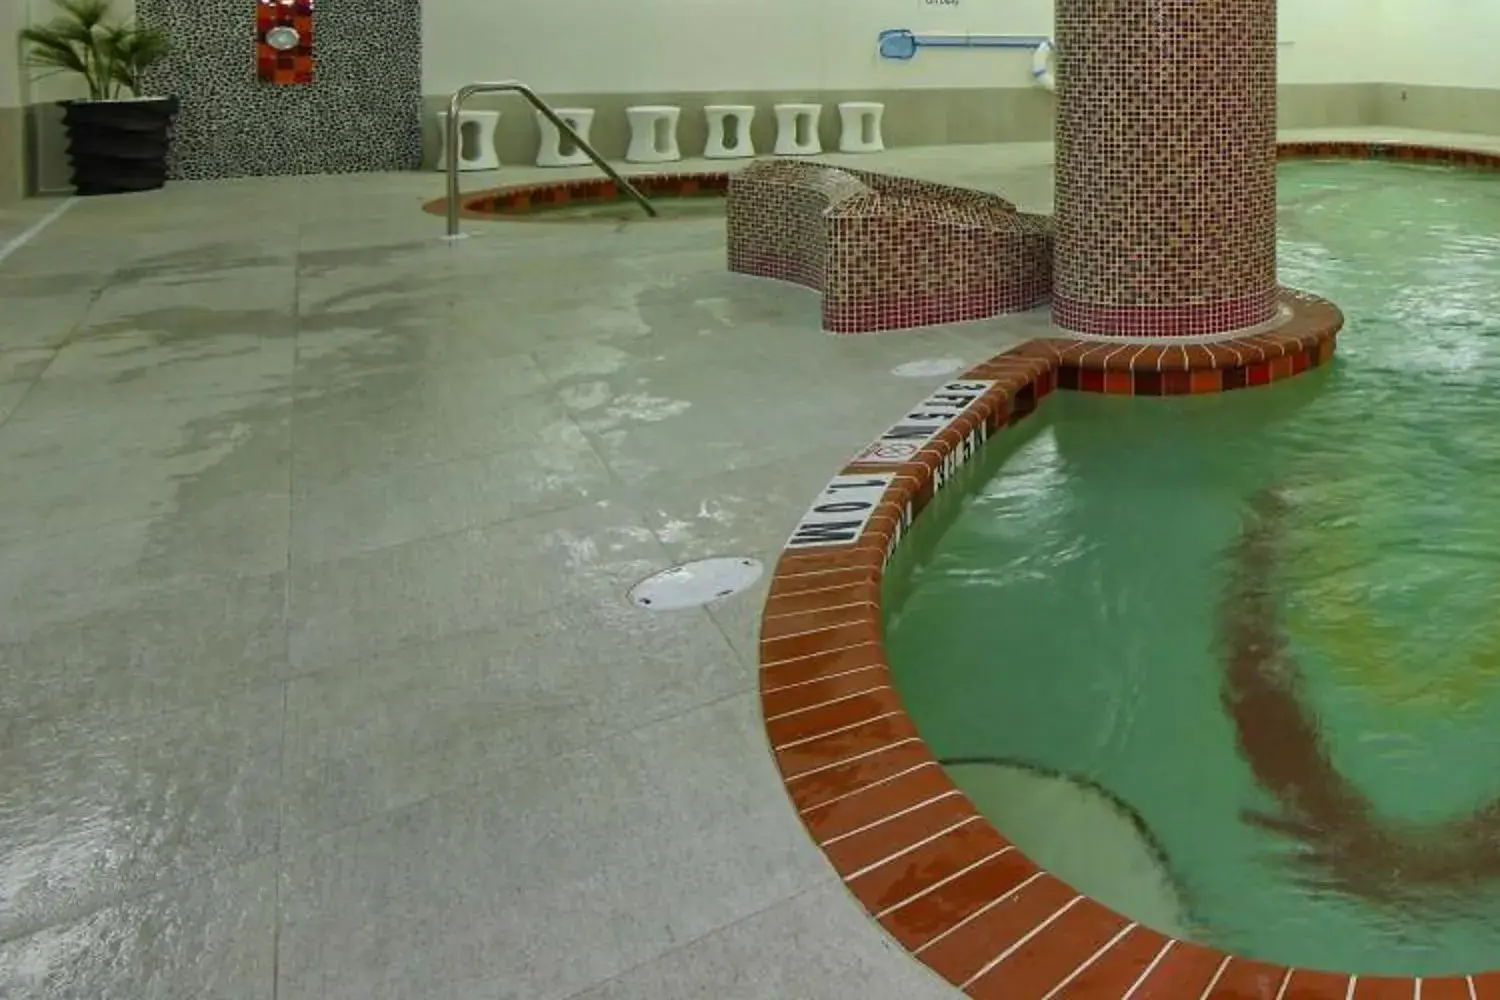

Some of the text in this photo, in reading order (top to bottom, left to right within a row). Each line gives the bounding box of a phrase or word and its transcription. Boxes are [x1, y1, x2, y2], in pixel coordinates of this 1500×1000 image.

[944, 383, 987, 391] 3
[925, 395, 978, 409] FT
[789, 520, 863, 545] M
